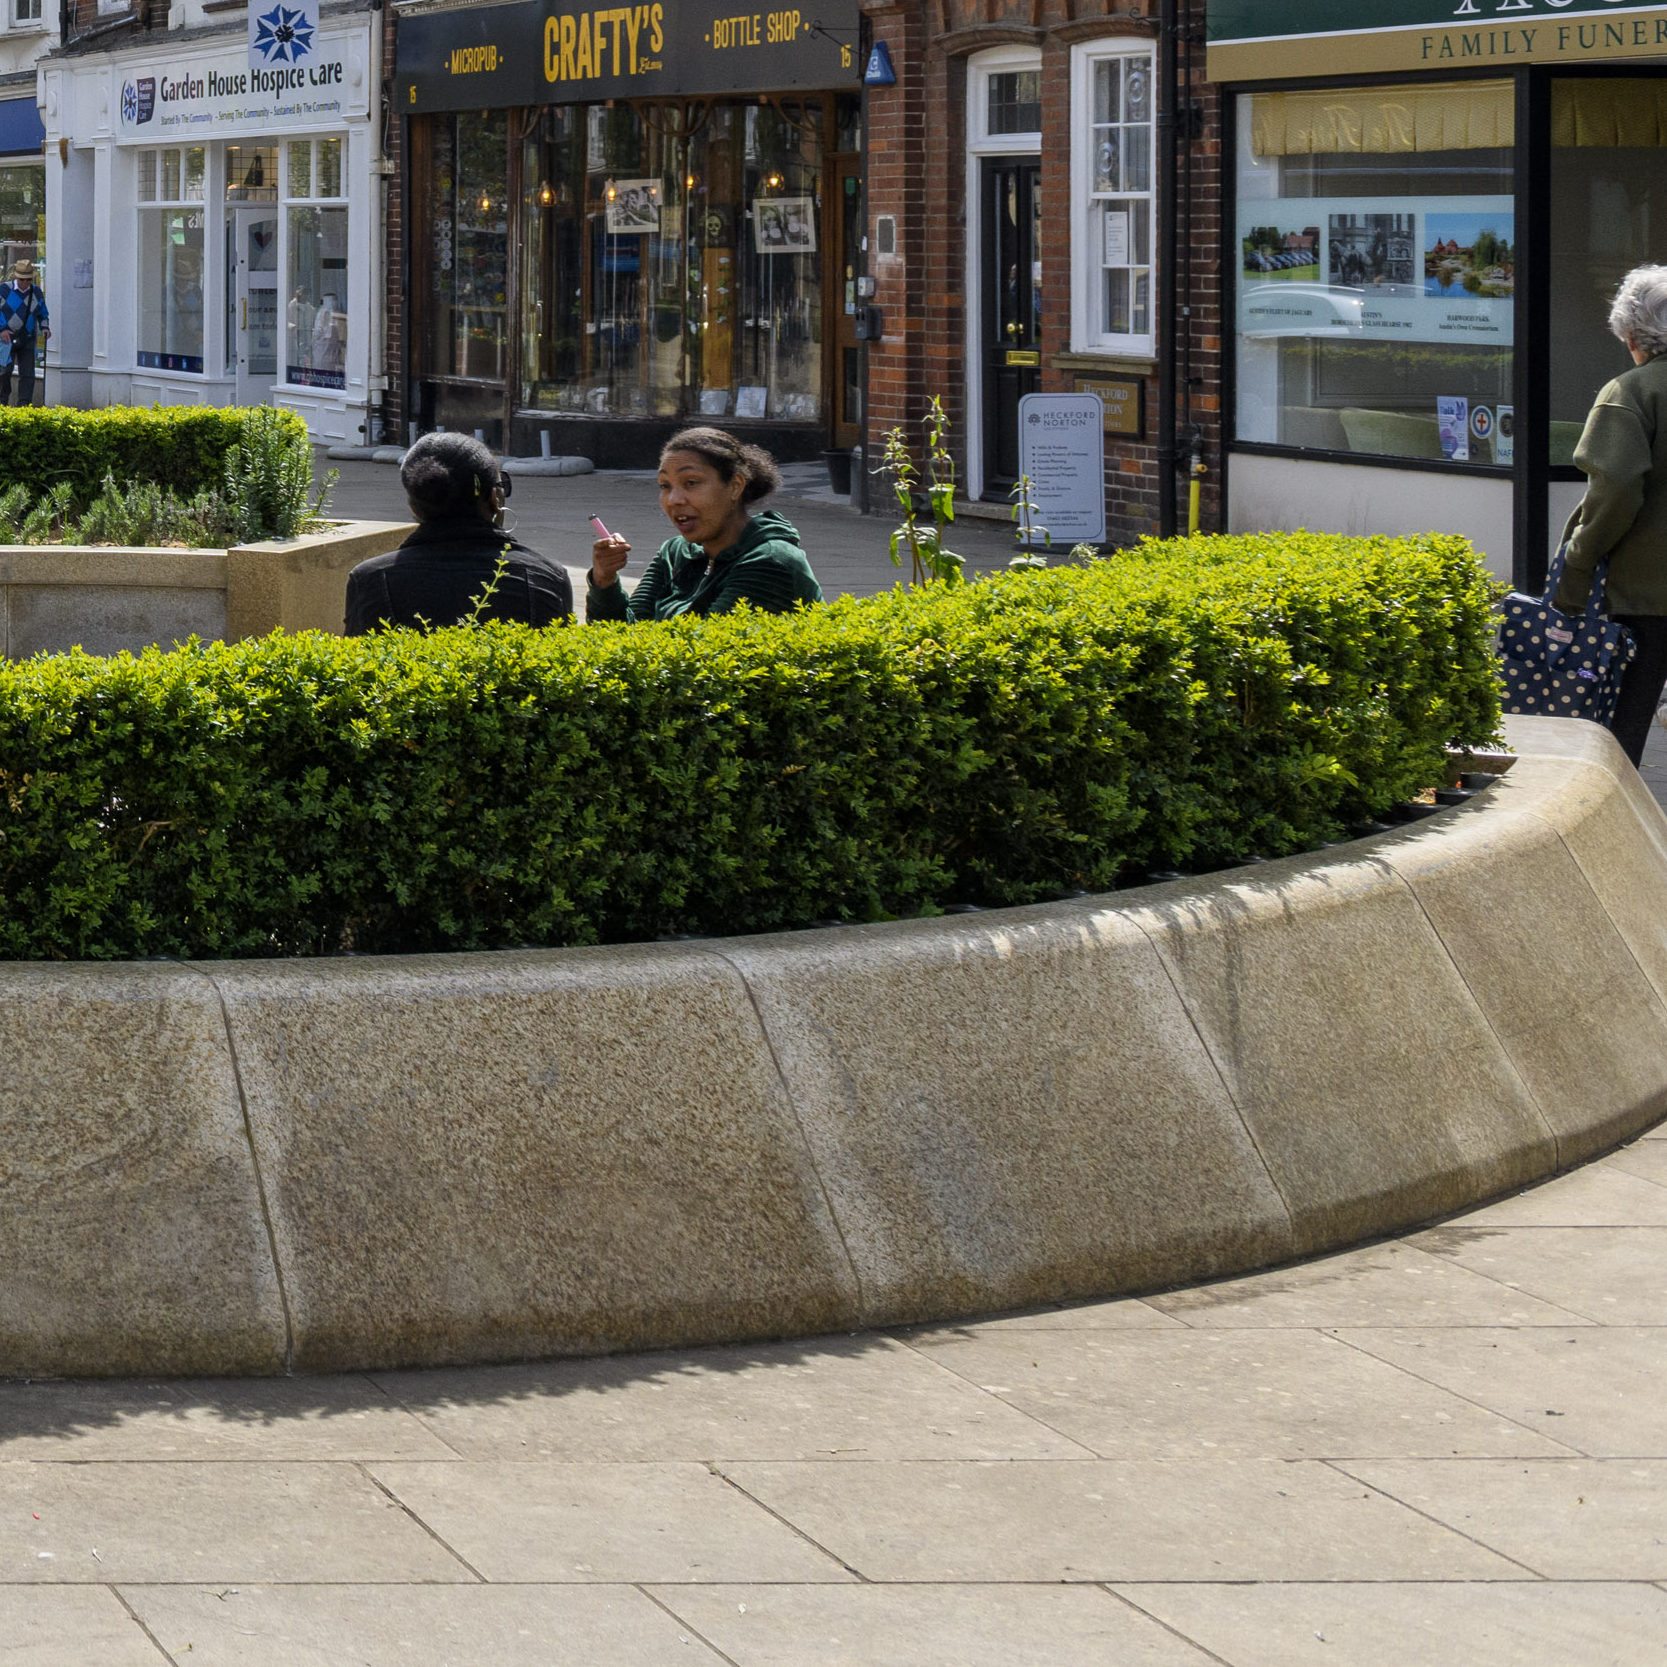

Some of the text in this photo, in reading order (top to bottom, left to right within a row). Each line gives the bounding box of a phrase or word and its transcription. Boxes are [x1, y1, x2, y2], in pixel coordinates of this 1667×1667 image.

[714, 10, 802, 49] BOTTLE SHOP
[544, 3, 664, 83] CRAFTY'S
[1421, 29, 1538, 60] FAMILY
[451, 45, 497, 74] MICROPUB
[840, 44, 852, 69] 15
[138, 82, 153, 91] Garden
[138, 92, 151, 100] House
[160, 72, 204, 103] Garden
[208, 70, 247, 97] House
[251, 67, 305, 100] Hospice
[410, 85, 416, 105] 15
[160, 100, 341, 126] Started By The Community Serving The Community Sustained By The Community
[1043, 411, 1096, 419] HECKFORD
